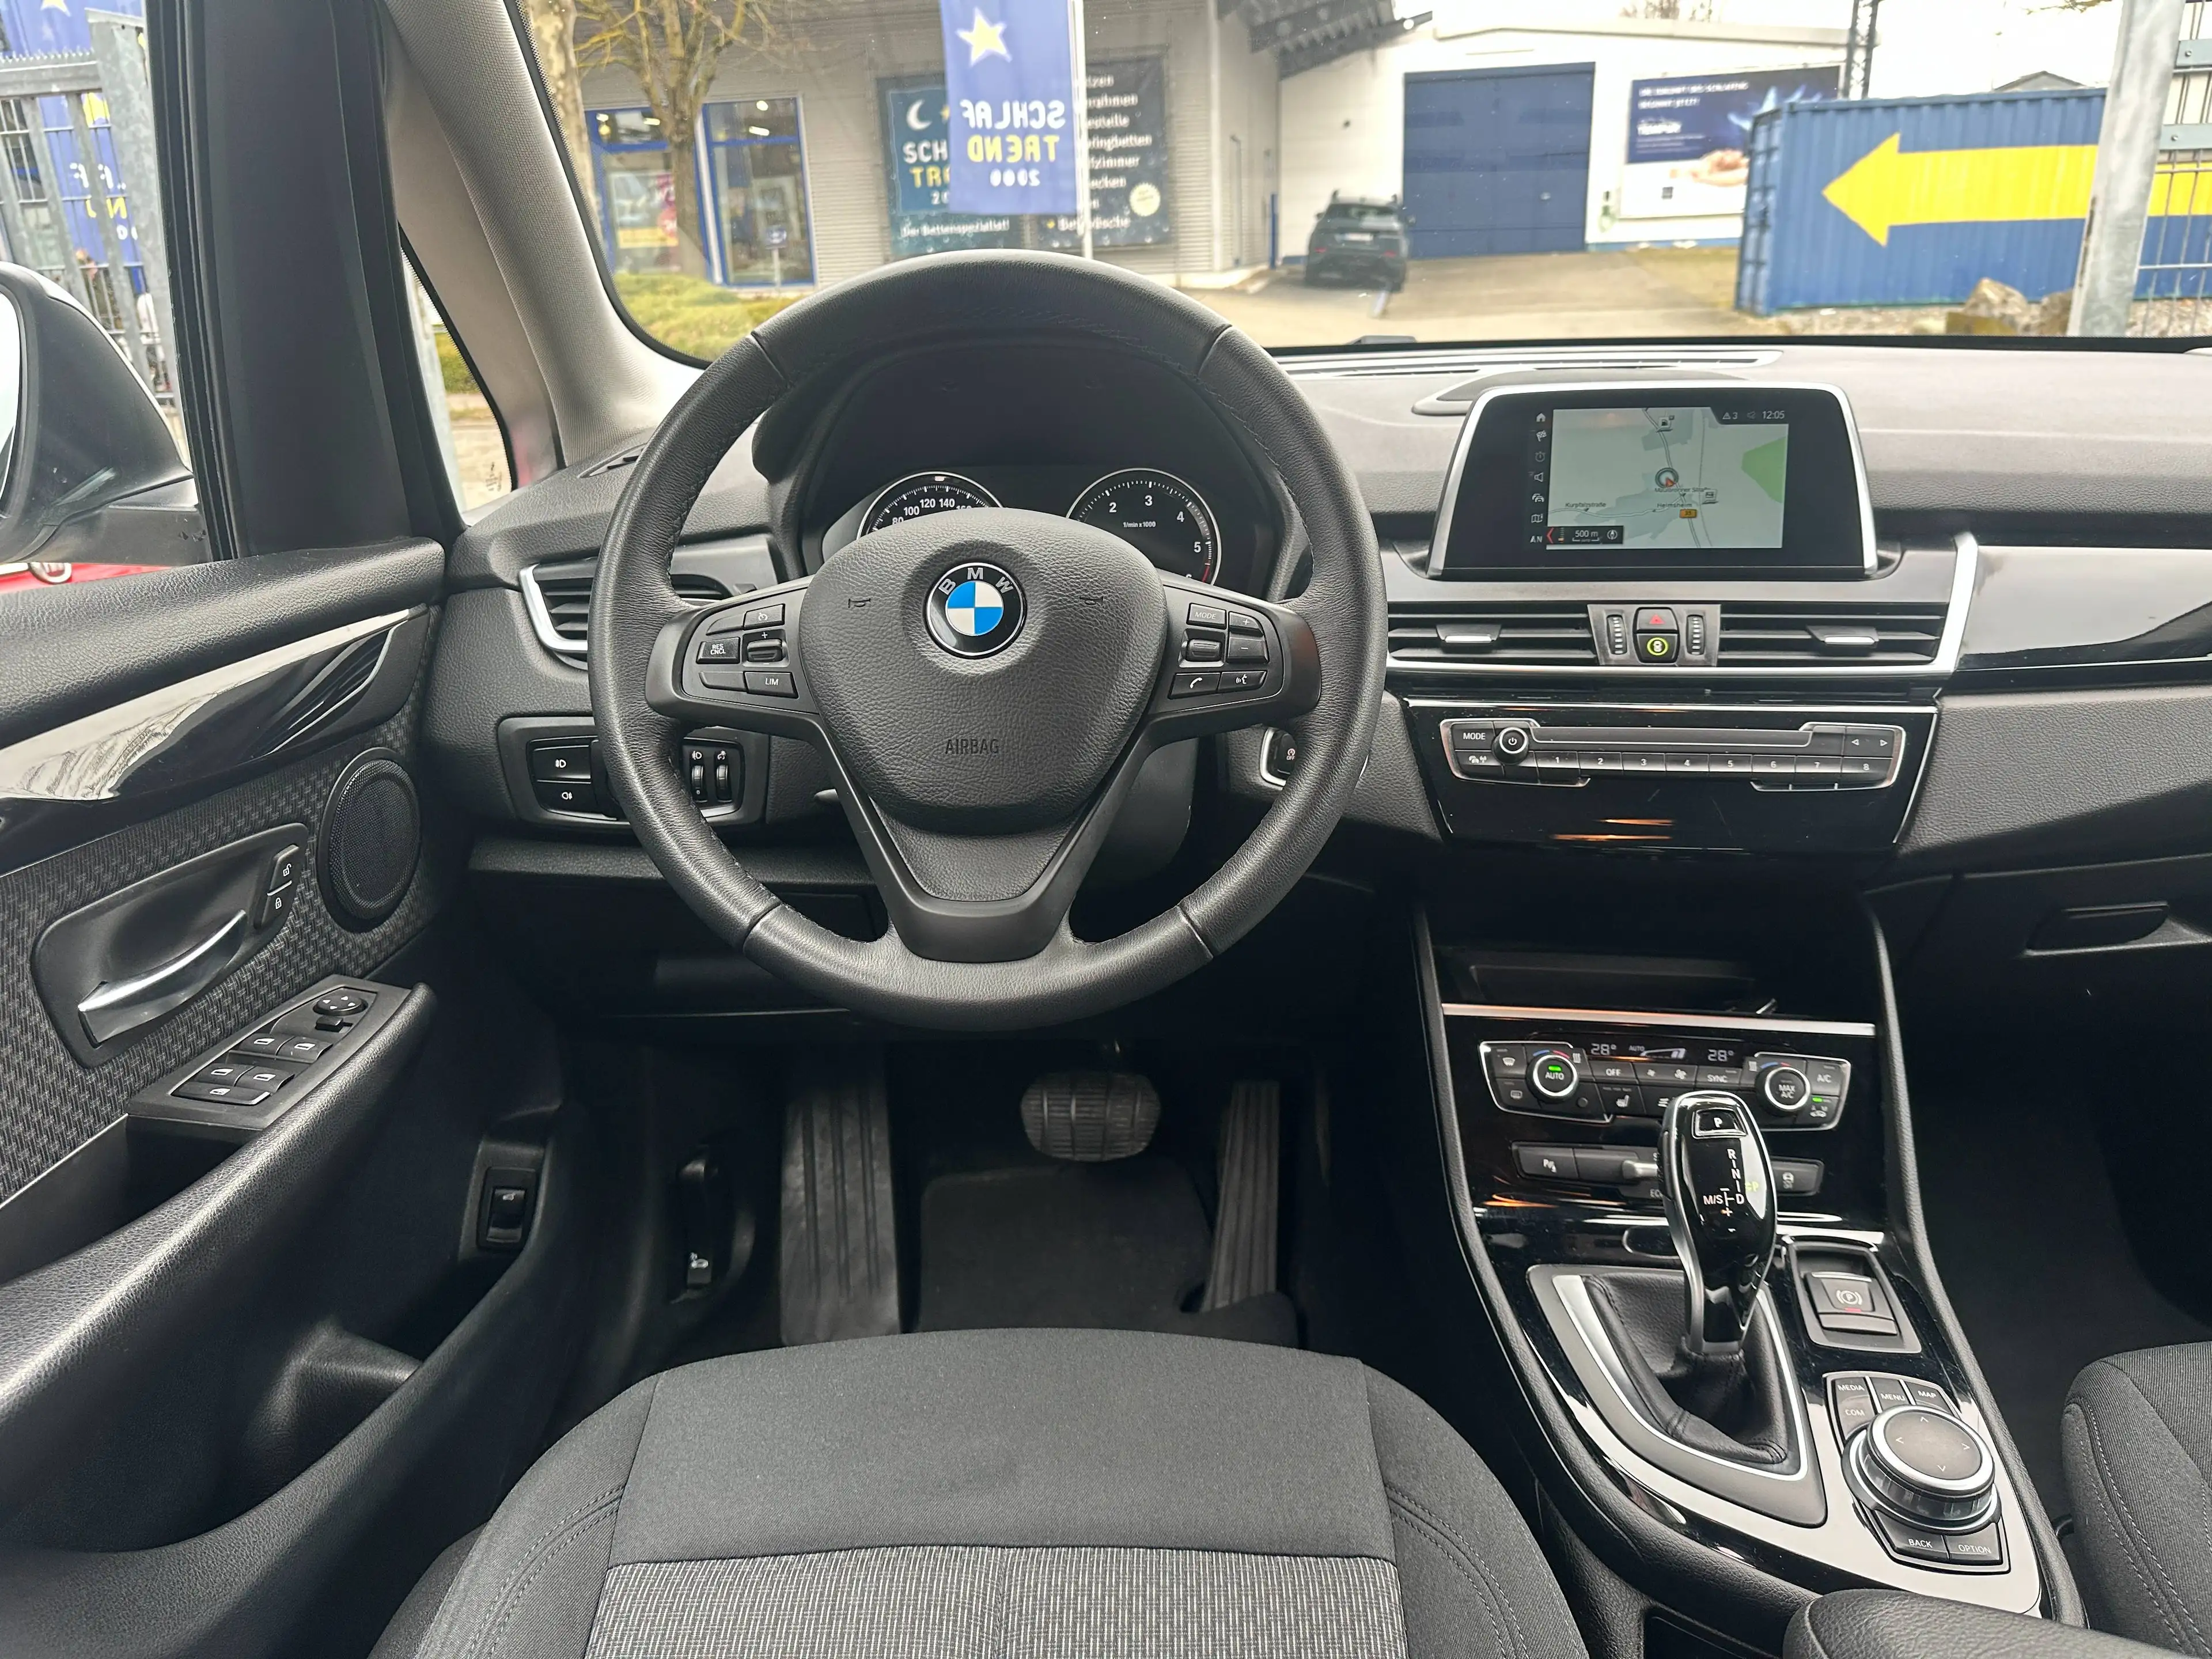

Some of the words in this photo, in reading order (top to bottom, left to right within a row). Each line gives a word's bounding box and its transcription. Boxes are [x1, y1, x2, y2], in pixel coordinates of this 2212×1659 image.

[1762, 410, 1785, 419] 12:05
[920, 499, 936, 509] 120
[939, 499, 955, 508] 140
[1145, 495, 1153, 506] 3
[904, 506, 919, 516] 100
[1109, 502, 1117, 513] 2
[1176, 512, 1184, 522] 4
[1575, 530, 1589, 538] 500
[1194, 541, 1201, 553] 5
[938, 567, 1014, 595] BMW
[1195, 611, 1216, 620] MODE
[765, 677, 779, 685] LIM
[1463, 732, 1486, 740] MODE
[945, 738, 999, 755] AIRBAG
[1546, 1072, 1565, 1080] AUTO
[1707, 1074, 1728, 1083] SYNC
[1778, 1084, 1796, 1092] MAX
[1714, 1117, 1723, 1128] P
[1727, 1149, 1736, 1159] R
[1731, 1169, 1741, 1179] N
[1703, 1194, 1724, 1205] M/S
[1736, 1194, 1745, 1205] D
[1880, 1393, 1906, 1401] MENU
[1918, 1390, 1937, 1399] MAP
[1908, 1539, 1933, 1548] BACK
[1958, 1544, 1992, 1554] OPTION
